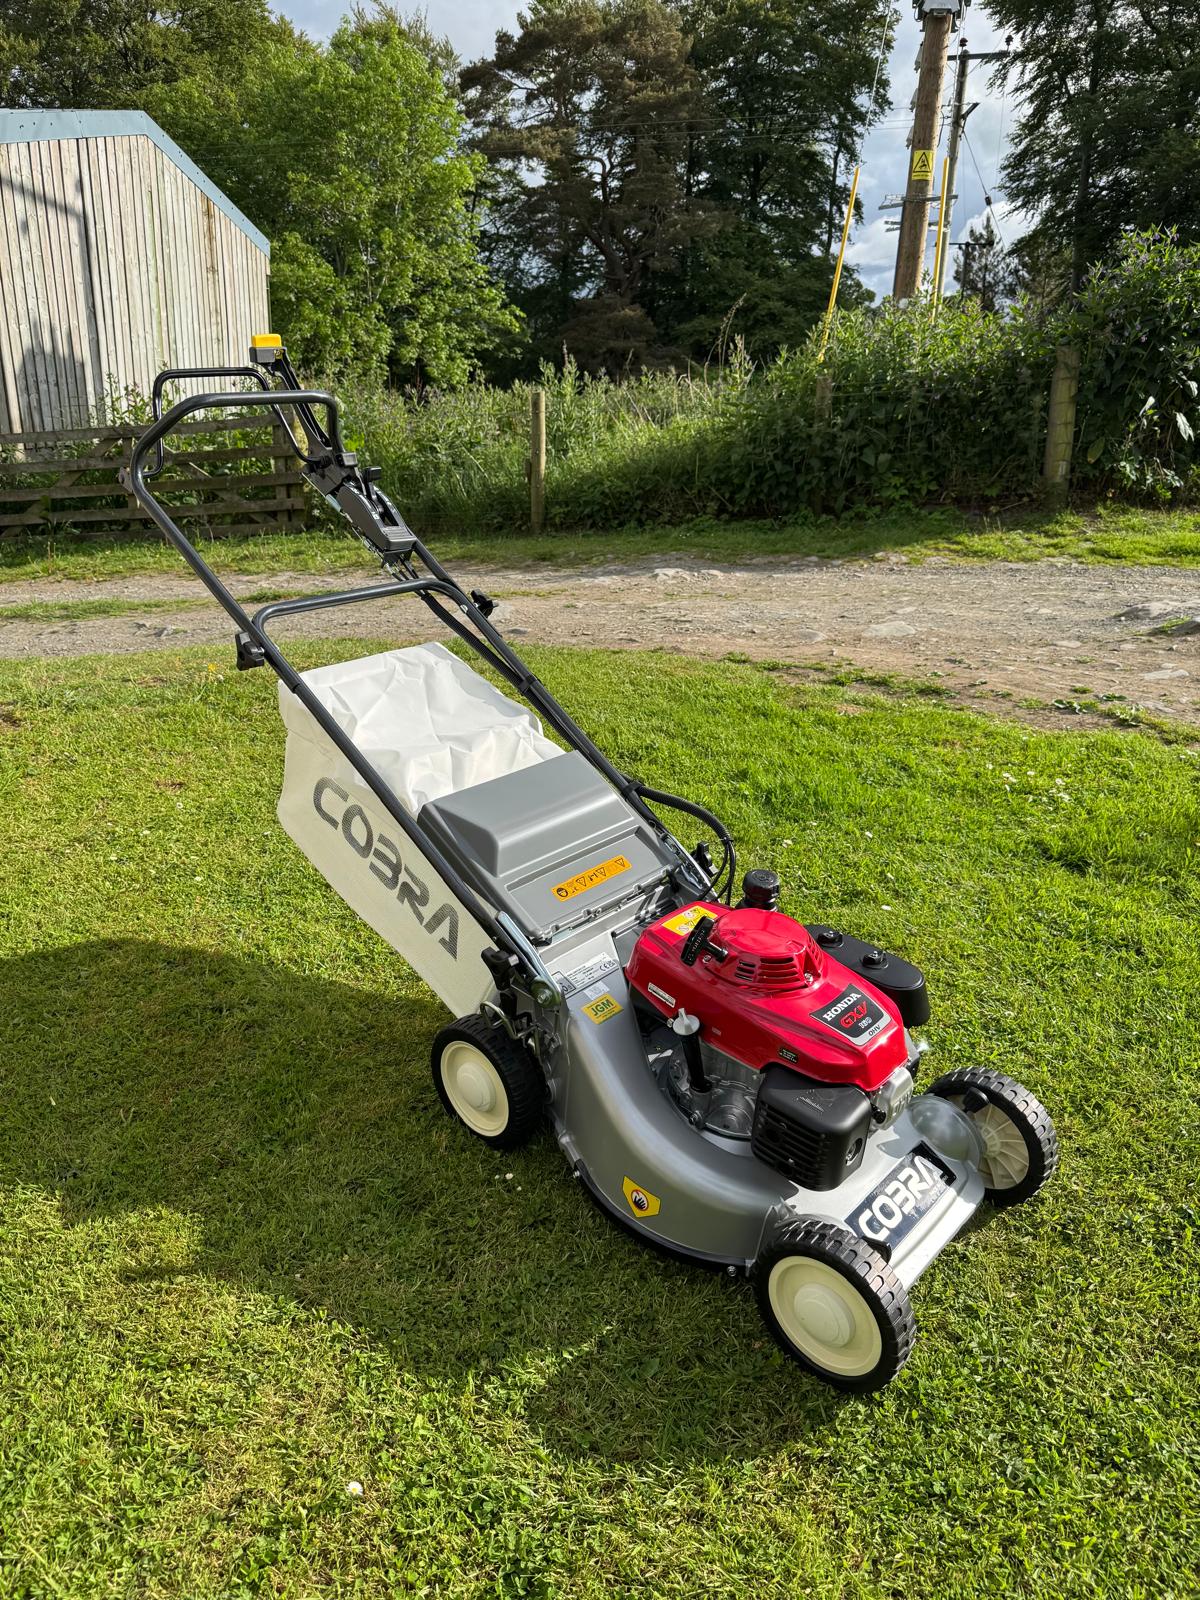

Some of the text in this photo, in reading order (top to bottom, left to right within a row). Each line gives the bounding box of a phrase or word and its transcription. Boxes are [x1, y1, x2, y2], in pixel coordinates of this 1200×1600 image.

[313, 777, 460, 961] COBRA
[591, 999, 614, 1016] JGM
[822, 992, 862, 1022] HONDA
[868, 1024, 881, 1037] OHV
[858, 1155, 944, 1242] COBRA
